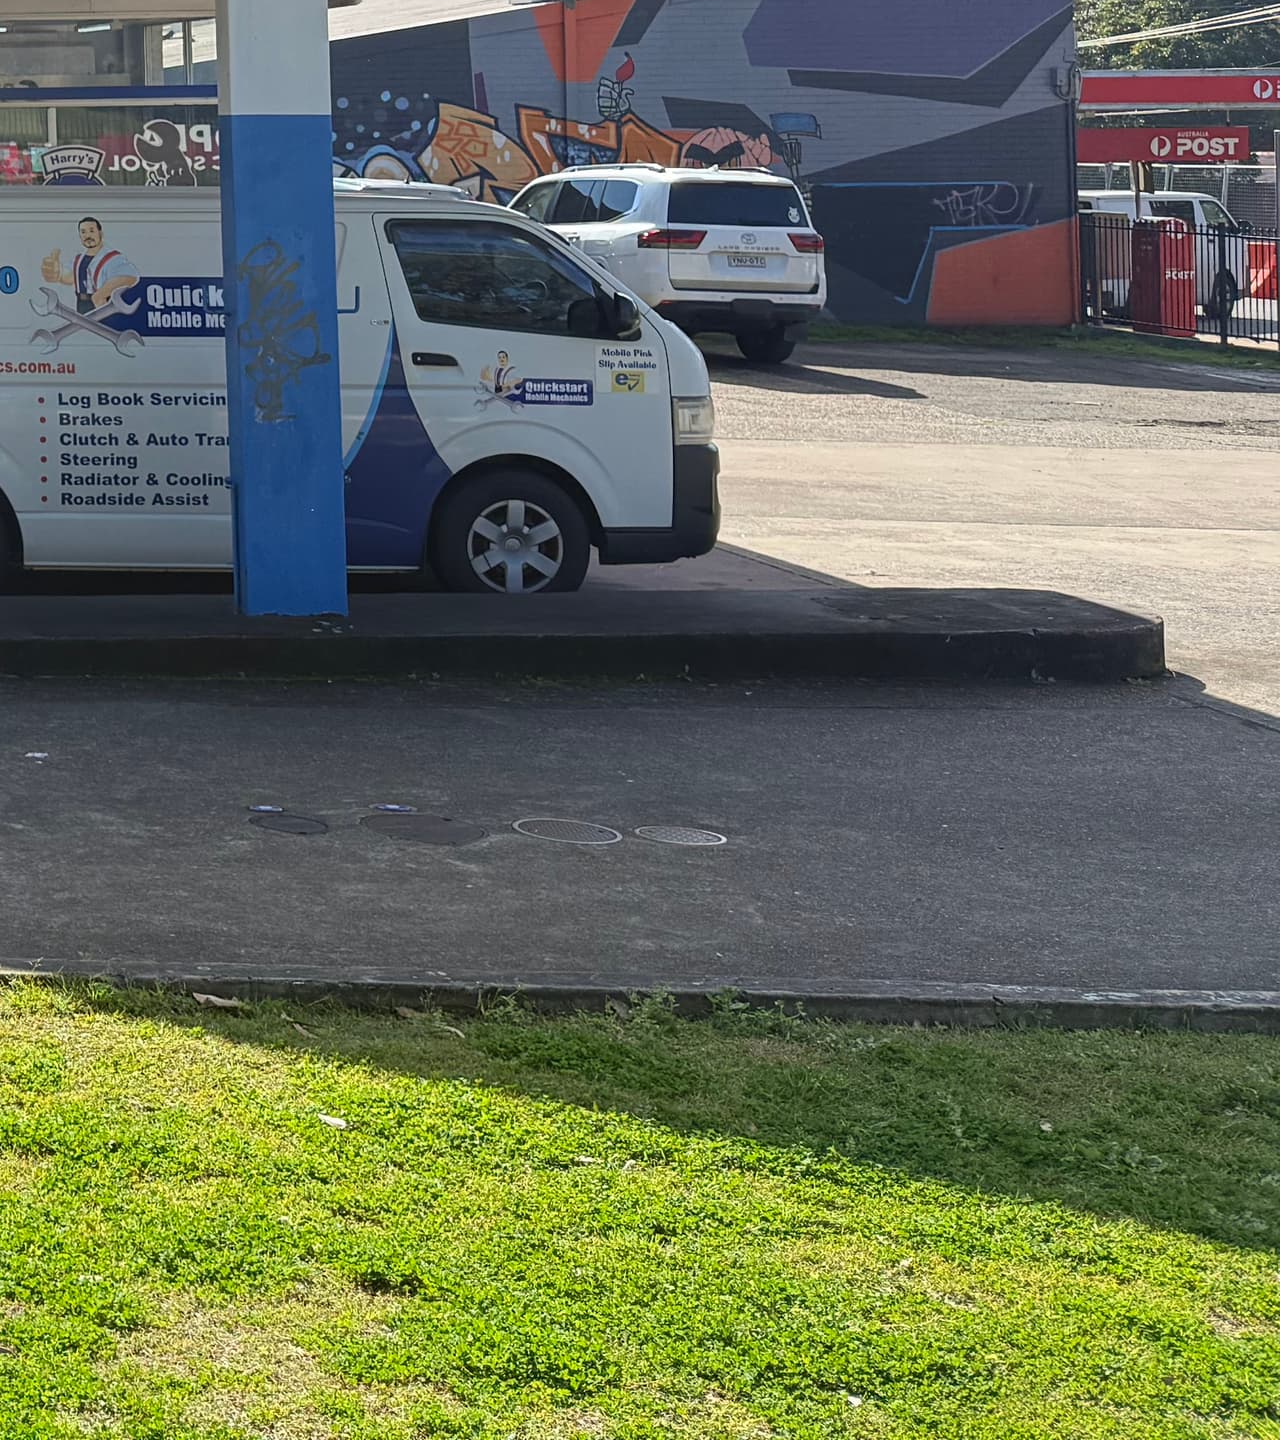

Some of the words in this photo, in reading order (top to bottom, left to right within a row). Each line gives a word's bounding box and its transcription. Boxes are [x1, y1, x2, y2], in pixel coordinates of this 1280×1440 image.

[1177, 138, 1239, 156] POST
[50, 152, 95, 166] Harry's
[146, 284, 224, 309] Quick
[148, 312, 202, 329] Mobile
[205, 313, 225, 329] Me
[601, 348, 630, 357] Mobile
[633, 348, 653, 357] Pink
[598, 360, 615, 370] Slip
[617, 360, 657, 369] Available
[525, 381, 588, 393] Quickstart
[58, 393, 91, 408] Log
[98, 393, 144, 406] Book
[150, 392, 227, 406] Servicin
[525, 393, 549, 401] Mobile
[550, 393, 588, 402] Mechanics
[59, 413, 123, 426] Brakes
[59, 433, 119, 446] Clutch
[126, 433, 139, 446] &
[146, 433, 189, 446] Auto
[195, 433, 230, 446] Tra
[60, 453, 138, 469] Steering
[61, 473, 139, 486] Radiator
[146, 473, 159, 486] &
[61, 493, 145, 506] Roadside
[152, 493, 209, 506] Assist
